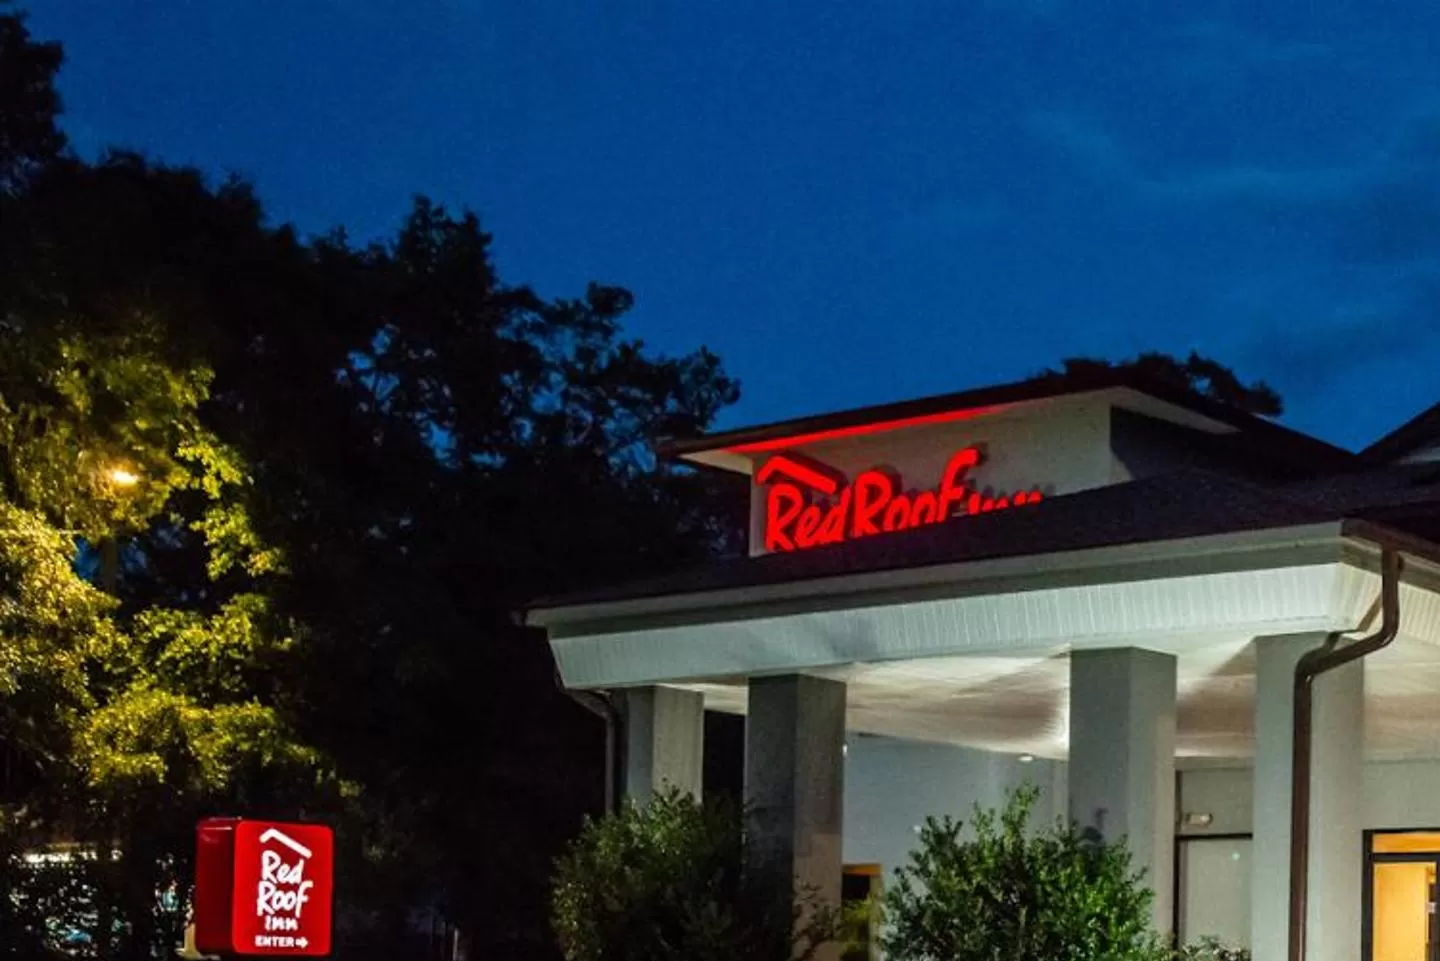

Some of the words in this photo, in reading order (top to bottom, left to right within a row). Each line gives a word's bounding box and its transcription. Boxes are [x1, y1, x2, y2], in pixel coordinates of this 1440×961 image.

[765, 482, 848, 551] Red
[852, 446, 981, 538] Roof
[261, 850, 305, 884] Red
[256, 879, 314, 918] Roof
[254, 935, 295, 948] ENTER
